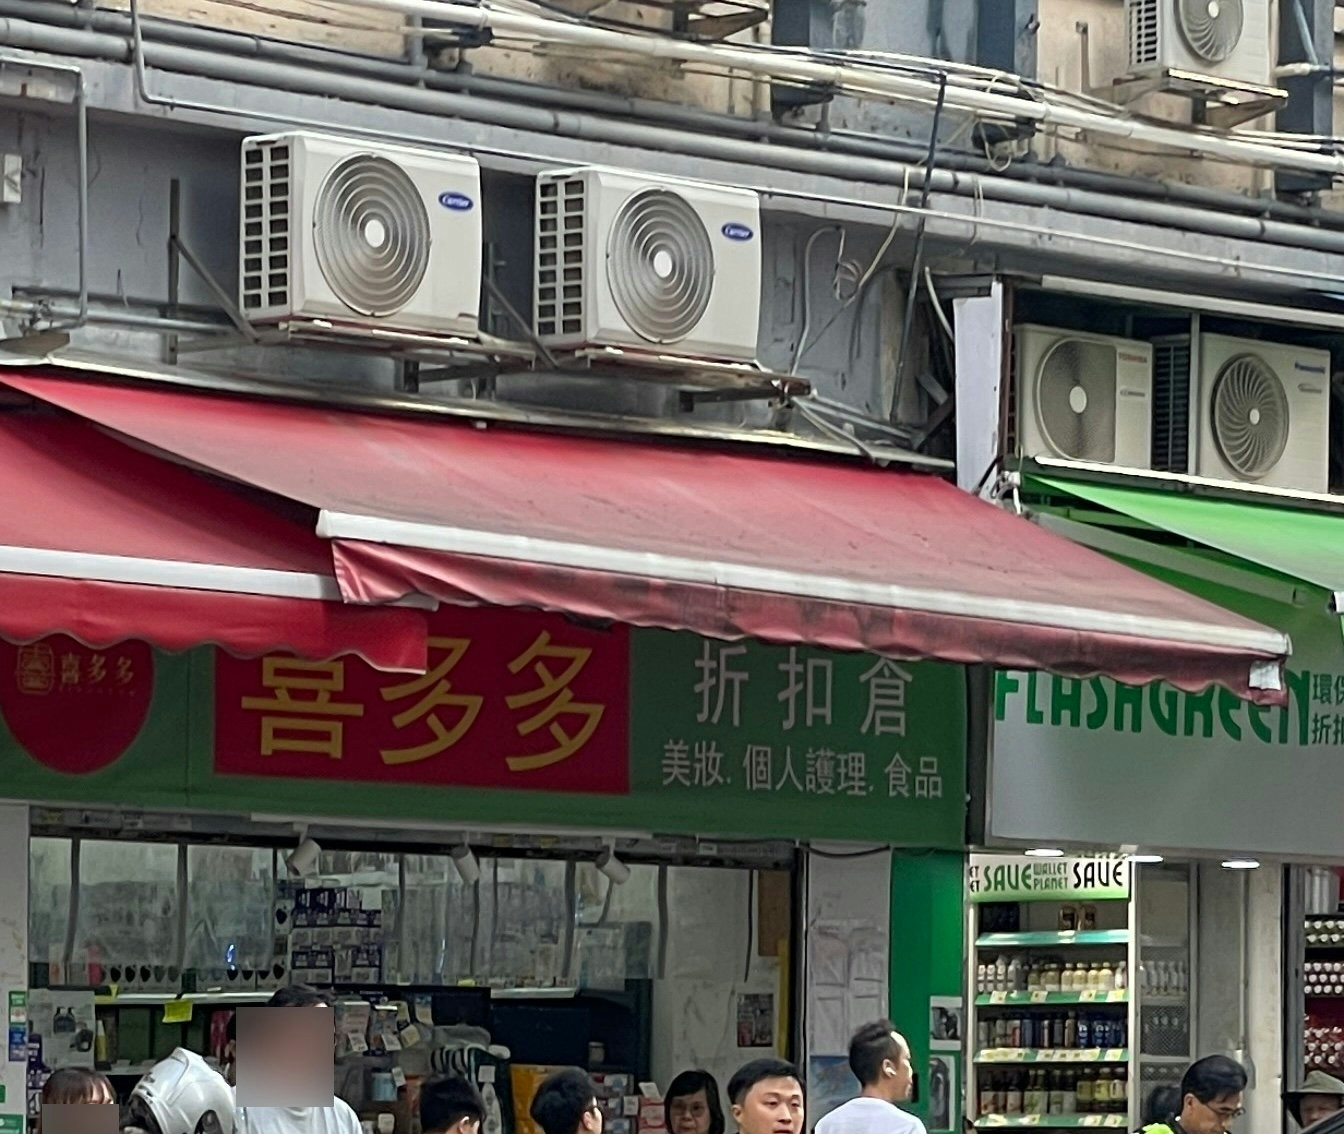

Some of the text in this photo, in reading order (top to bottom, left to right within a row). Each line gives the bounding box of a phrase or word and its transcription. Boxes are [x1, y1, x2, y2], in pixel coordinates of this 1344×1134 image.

[241, 630, 606, 772] 喜多多
[694, 641, 913, 737] 折扣倉
[884, 752, 943, 799] 食品
[983, 863, 1032, 893] SAVE
[1033, 862, 1068, 876] WALLET
[1033, 877, 1068, 891] PLANET
[1073, 861, 1124, 889] SAVE
